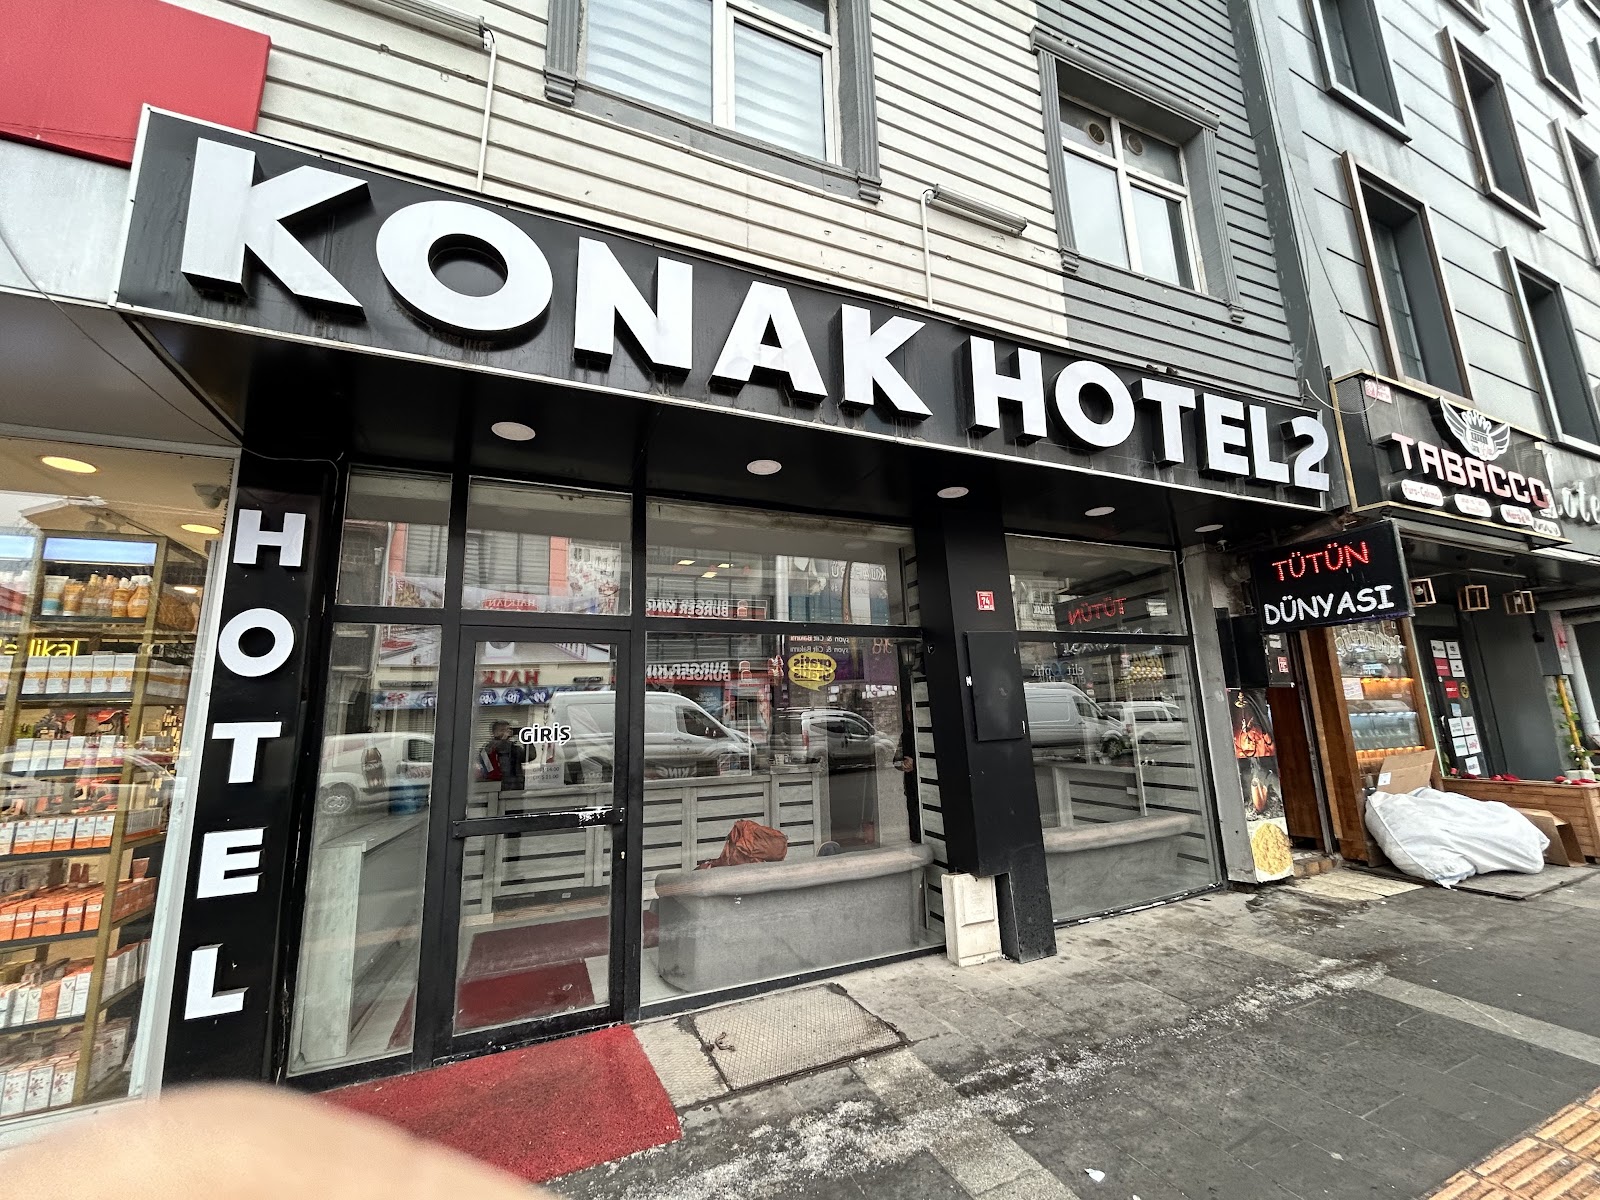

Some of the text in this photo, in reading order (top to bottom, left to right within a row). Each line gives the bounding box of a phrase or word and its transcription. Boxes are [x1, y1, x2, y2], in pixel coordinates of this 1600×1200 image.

[181, 136, 933, 419] KONAK
[1391, 432, 1549, 509] TABACCO
[1271, 541, 1369, 581] TÜTÜN
[1264, 584, 1395, 625] DÜNYASI
[519, 722, 571, 746] GİRİŞ
[184, 508, 307, 1020] HOTEL
